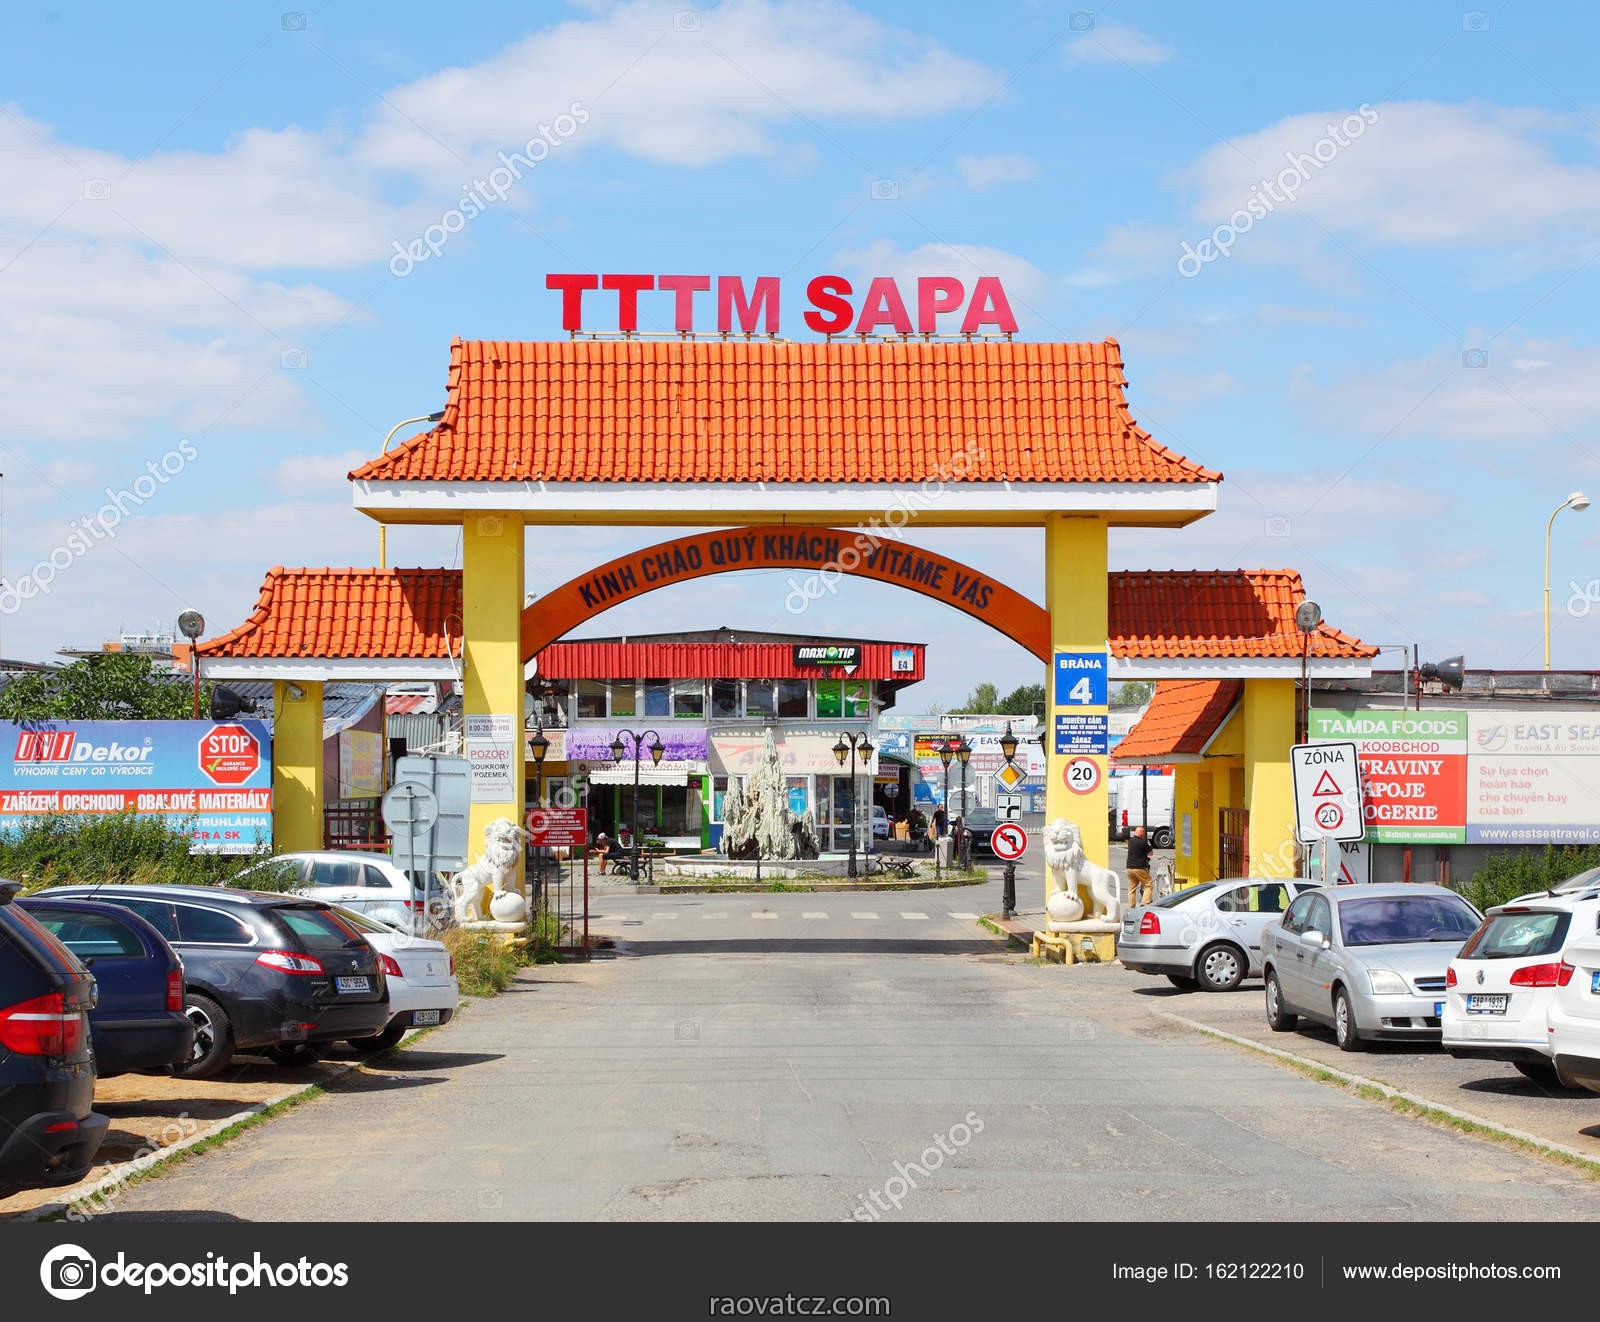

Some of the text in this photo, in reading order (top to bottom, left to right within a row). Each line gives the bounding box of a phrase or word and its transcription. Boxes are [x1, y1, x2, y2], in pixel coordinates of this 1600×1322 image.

[546, 274, 1019, 334] TTTM SAPA
[578, 563, 638, 609] KÍNH
[641, 545, 703, 582] CHÀO
[710, 532, 756, 565] QUÝ
[763, 531, 840, 563] KHÁCH
[864, 543, 948, 590] VÍTÁME
[952, 571, 995, 610] VÁS
[798, 647, 855, 659] MAXI TIP
[898, 660, 908, 670] E4
[1060, 658, 1103, 669] BRÁNA
[1070, 677, 1092, 705] 4
[1318, 719, 1458, 735] TAMDA FOODS
[1514, 724, 1562, 740] EAST
[209, 735, 251, 753] STOP
[1358, 741, 1440, 753] KOOBCHOD
[1514, 743, 1542, 752] Travel
[470, 750, 509, 760] POZOR!
[1304, 748, 1345, 765] ZÓNA
[13, 765, 154, 776] VÝHODNÉ CENY OD VÝROBCE
[1072, 767, 1092, 781] 20
[1360, 760, 1444, 775] TRAVINY
[1521, 766, 1549, 777] chọn
[1362, 782, 1426, 798] APOJE
[2, 792, 60, 811] ZAŘÍZENÍ
[63, 794, 125, 811] OBCHODU
[138, 790, 196, 809] OBALOVÉ
[199, 789, 269, 809] MATERIÁLY
[1479, 793, 1500, 803] cho
[1548, 793, 1567, 804] bay
[1321, 809, 1338, 823] 20
[1364, 805, 1439, 821] OGERIE
[193, 830, 240, 840] ČR A SK
[1340, 842, 1361, 854] NA
